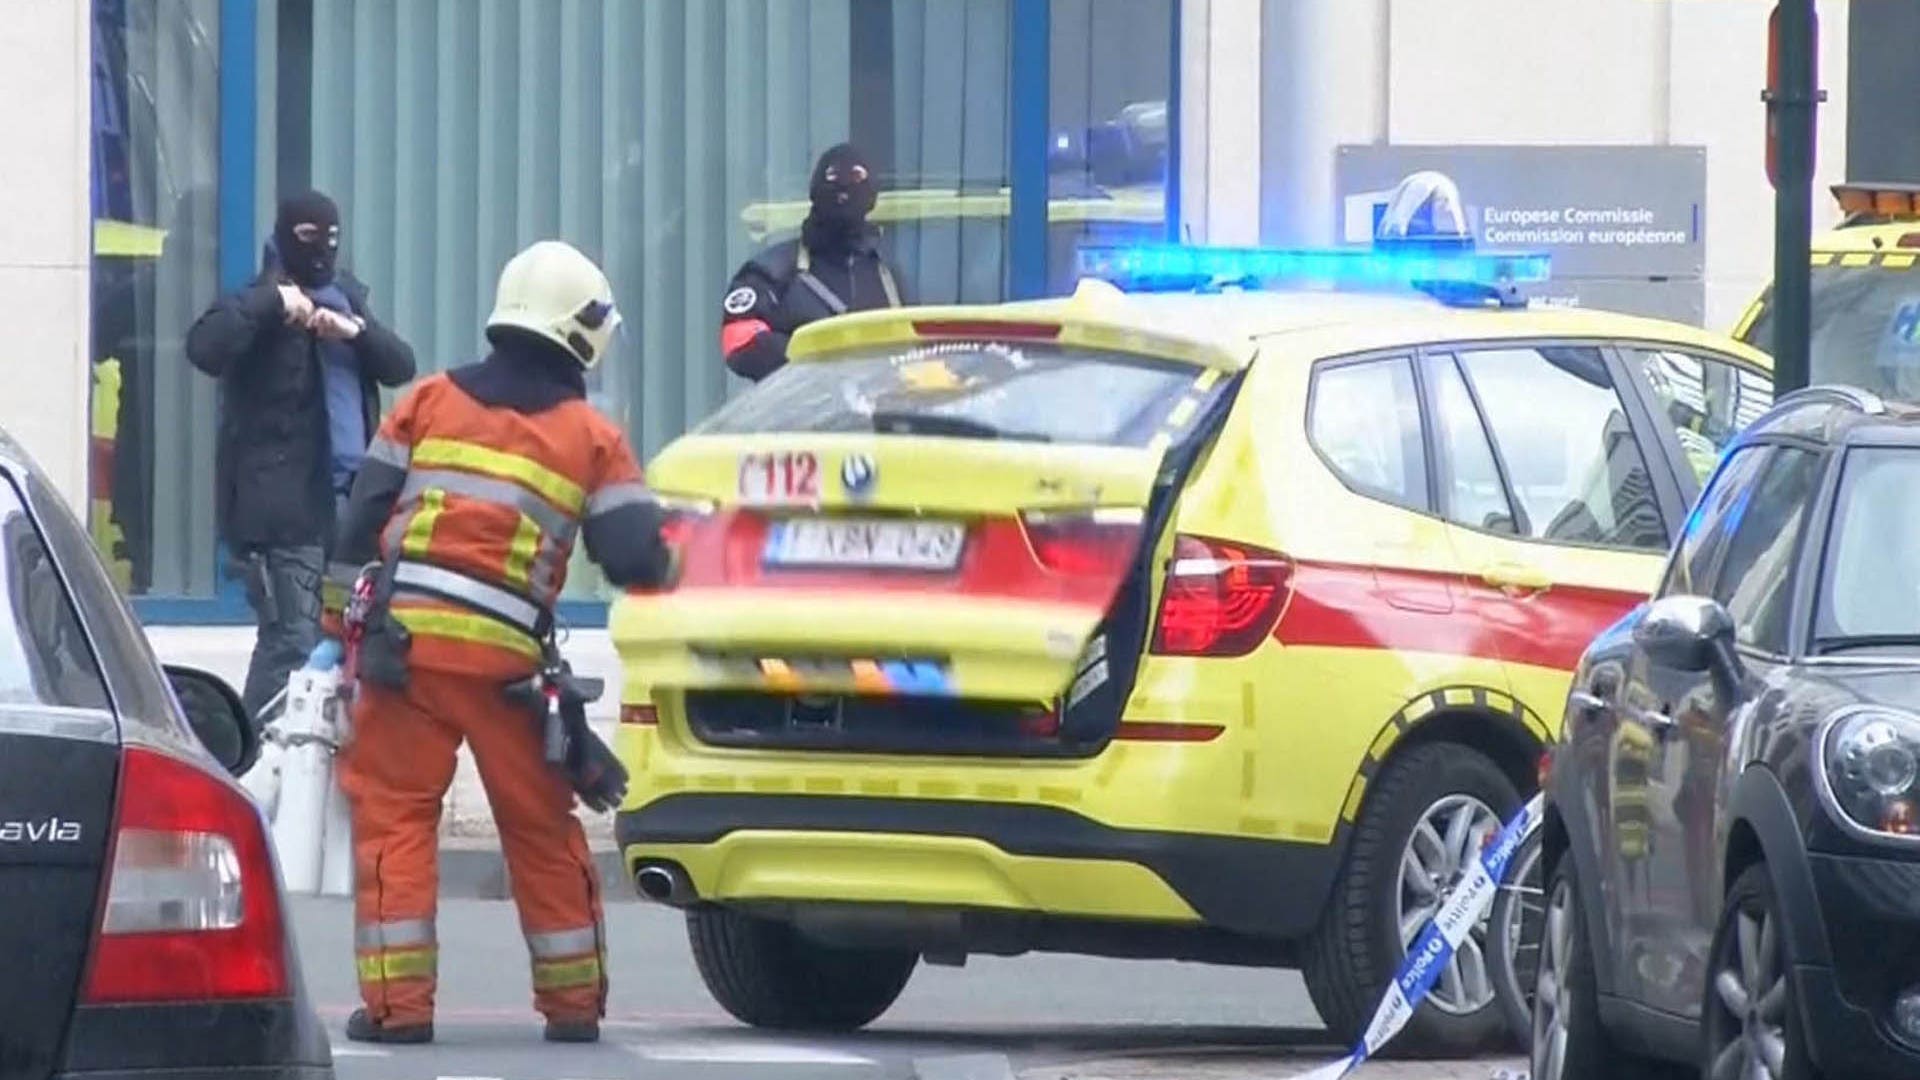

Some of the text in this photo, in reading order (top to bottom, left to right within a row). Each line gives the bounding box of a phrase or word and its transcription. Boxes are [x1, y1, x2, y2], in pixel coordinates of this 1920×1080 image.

[1484, 207, 1654, 226] Europese Commissie
[1485, 227, 1686, 246] Commission européenne
[764, 451, 818, 496] 112
[0, 817, 81, 842] avia
[1402, 950, 1434, 989] Police
